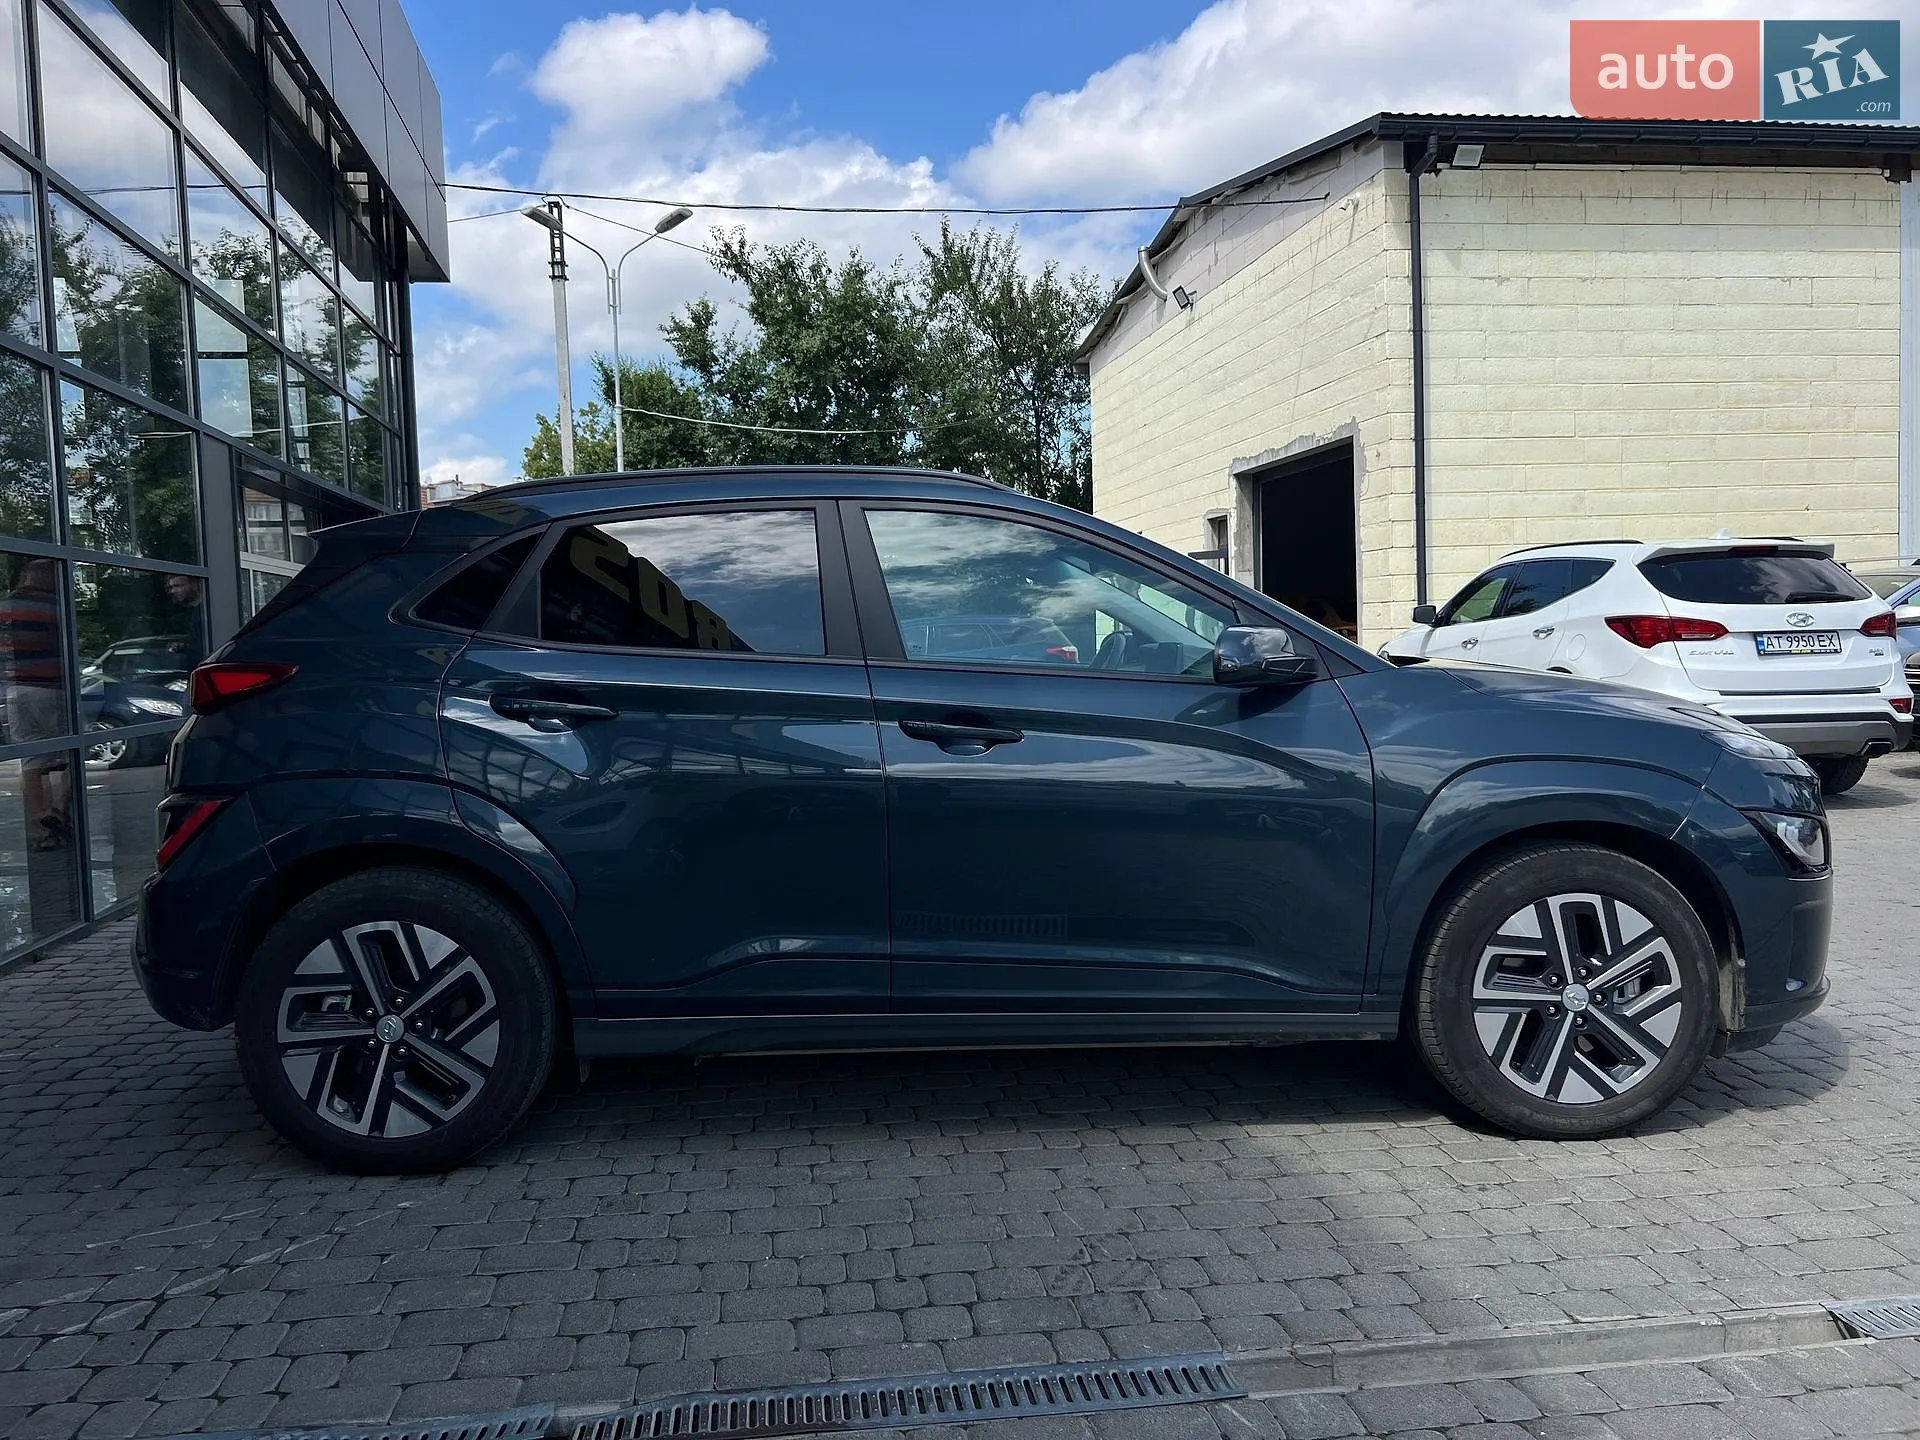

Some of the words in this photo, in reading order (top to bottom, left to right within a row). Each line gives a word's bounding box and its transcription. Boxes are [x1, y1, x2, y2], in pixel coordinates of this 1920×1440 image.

[1766, 635, 1783, 649] AT
[1786, 635, 1816, 649] 9950
[1817, 634, 1836, 648] EX
